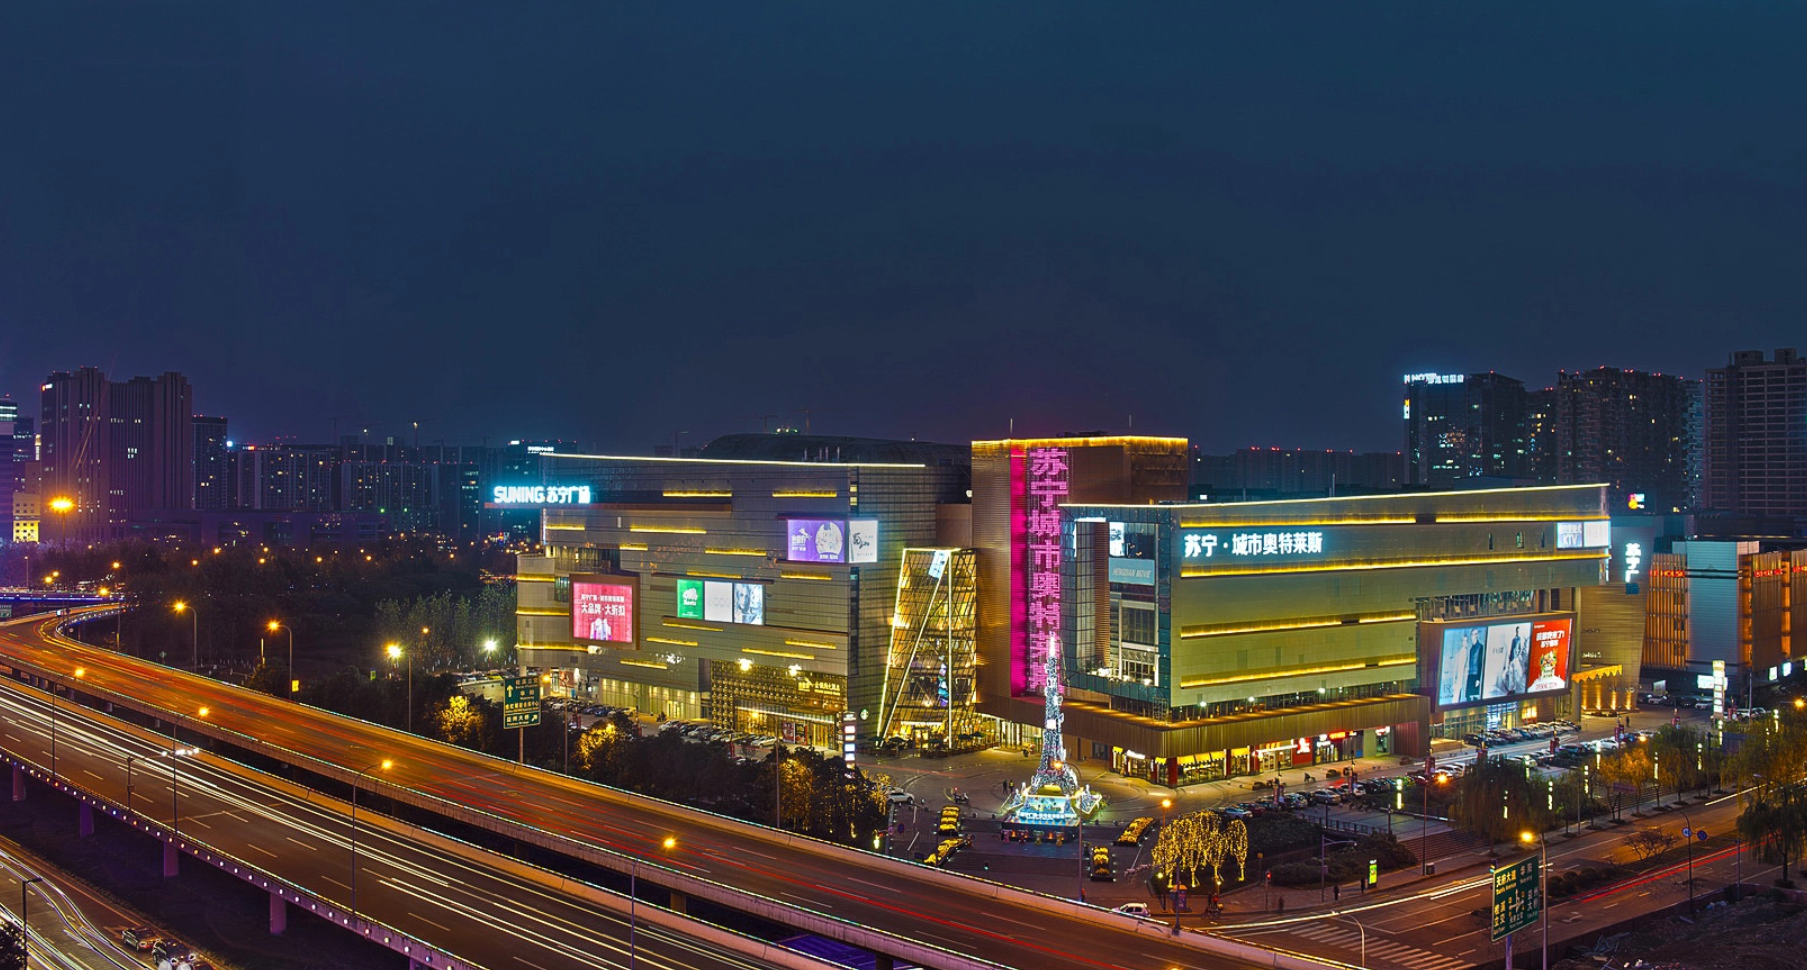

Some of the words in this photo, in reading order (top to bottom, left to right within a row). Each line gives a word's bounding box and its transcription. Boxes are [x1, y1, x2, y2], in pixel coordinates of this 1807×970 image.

[493, 485, 546, 504] SUNING
[546, 485, 591, 504] 苏宁广场
